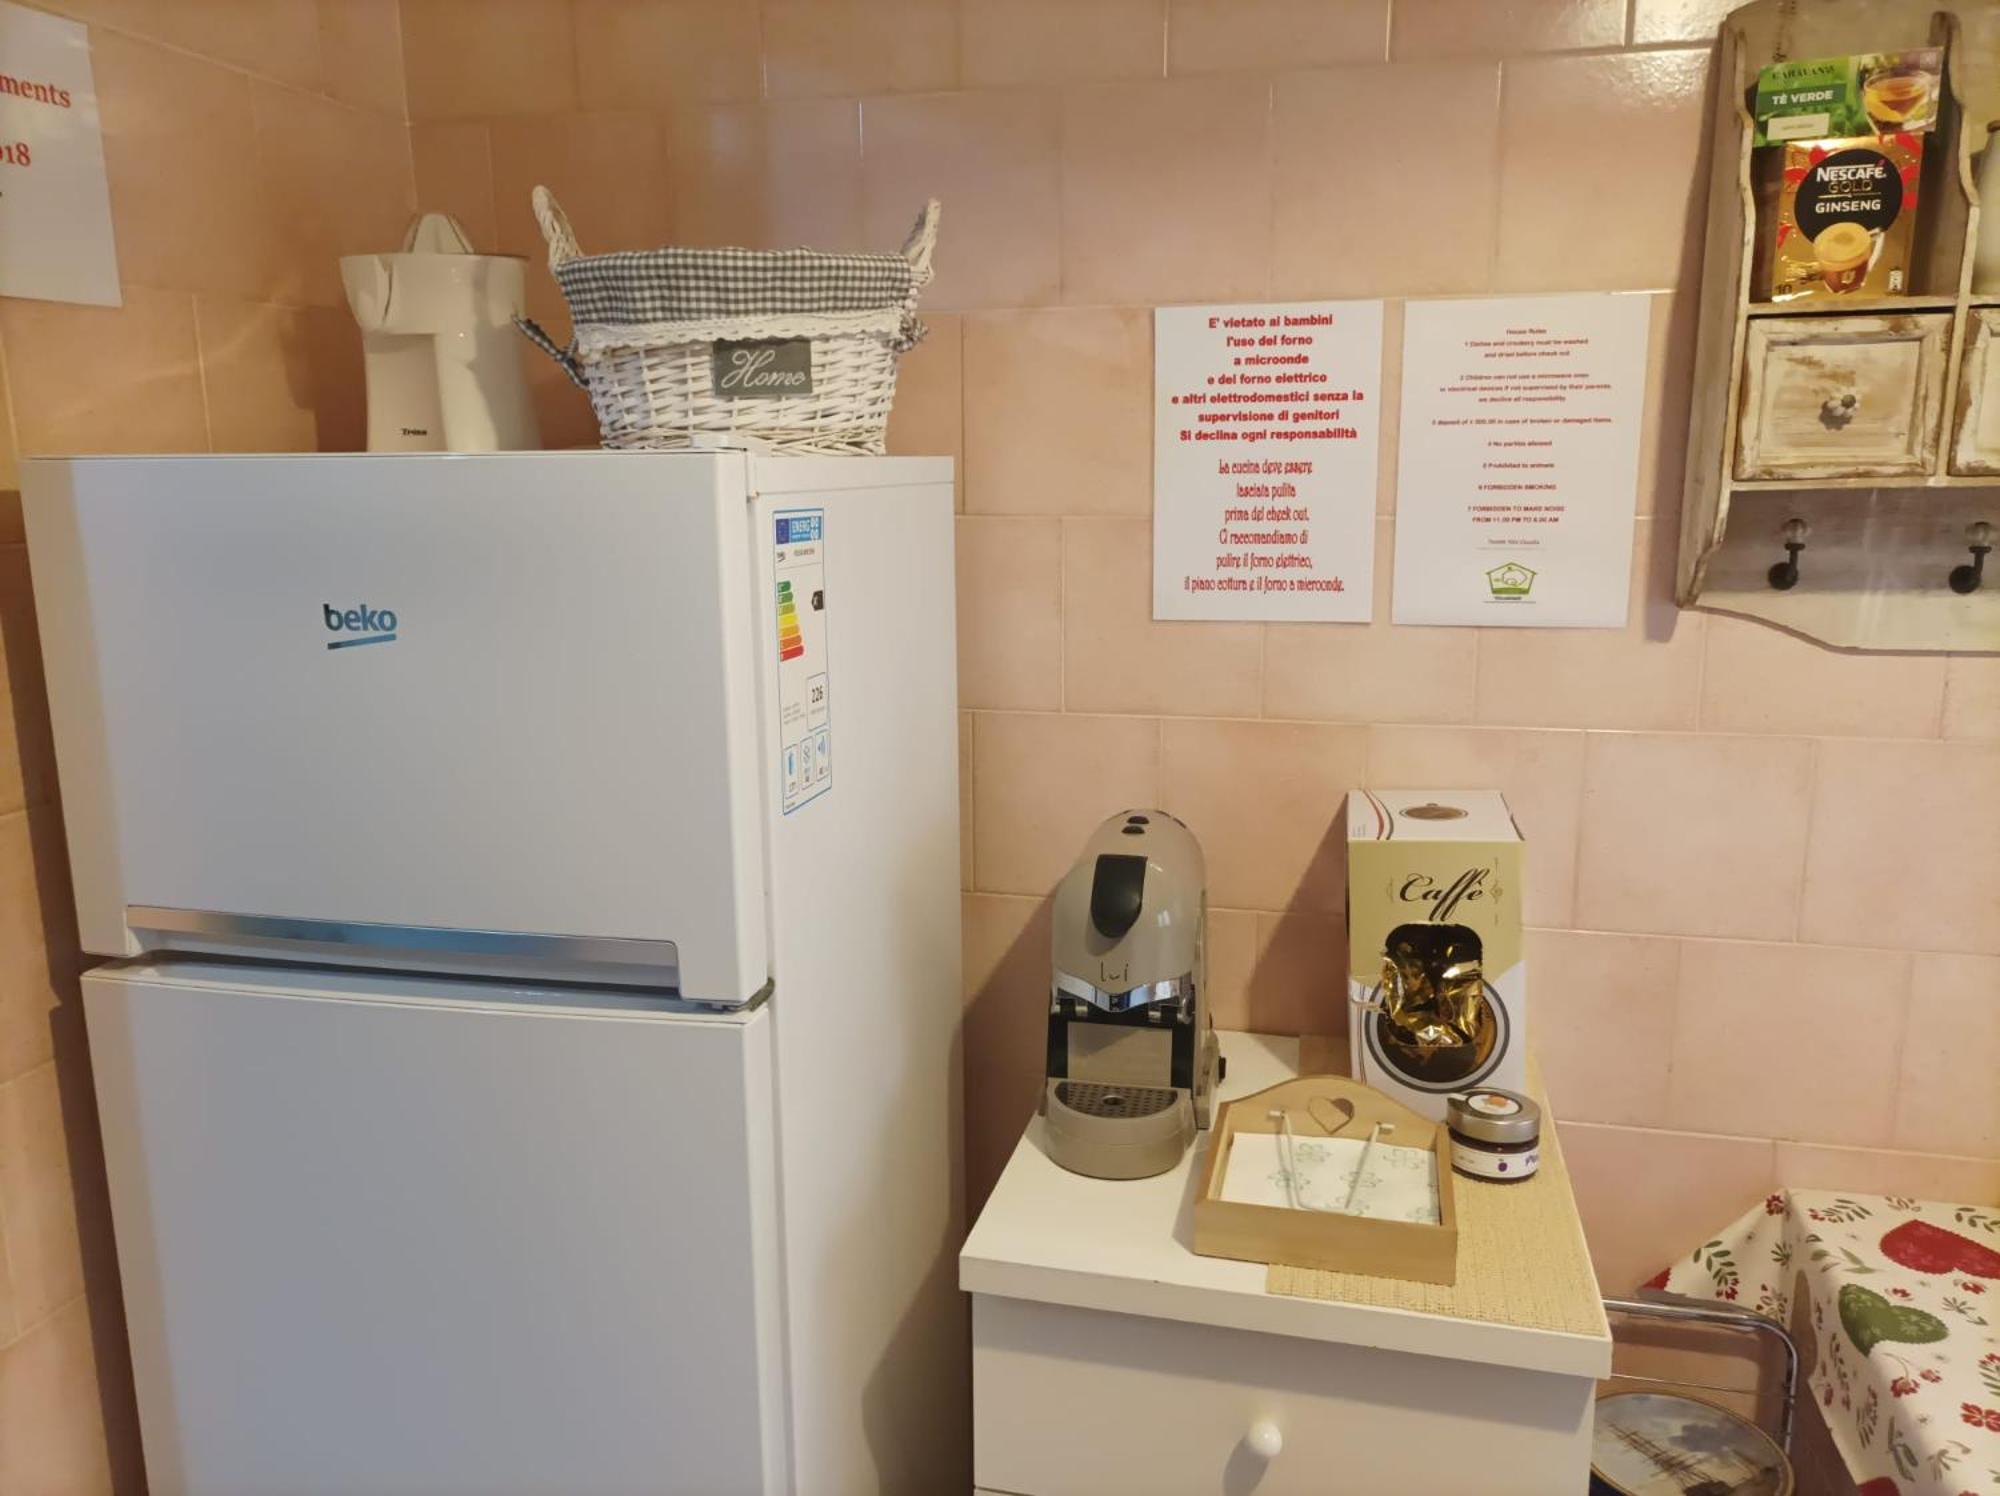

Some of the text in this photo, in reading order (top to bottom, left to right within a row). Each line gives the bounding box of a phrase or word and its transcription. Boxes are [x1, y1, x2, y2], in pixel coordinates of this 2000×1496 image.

[1791, 90, 1834, 103] VERDE
[0, 141, 31, 167] 18
[1828, 180, 1873, 194] GOLD
[1815, 200, 1881, 214] GINSENG
[1224, 318, 1265, 328] vietato
[1270, 316, 1280, 327] ai
[1284, 314, 1333, 326] bambini
[1227, 335, 1313, 347] l'uso del forno
[1234, 354, 1309, 366] a microonde
[721, 349, 806, 389] Home
[1207, 373, 1328, 385] e del forno elettrico
[1172, 390, 1363, 404] e altri elettrodomestici senza la
[1198, 409, 1339, 424] supervisione di genitori
[1180, 428, 1357, 442] Si declina ogni responsabilità
[1219, 459, 1312, 474] La cucina deve essere
[1237, 483, 1296, 501] lasciata pulita
[1225, 507, 1249, 523] prima
[1251, 506, 1264, 522] del
[1266, 506, 1291, 522] check
[1219, 528, 1308, 545] Ci raccomandiamo di
[1216, 553, 1241, 570] pulire
[1243, 552, 1248, 567] il
[1250, 552, 1273, 570] forno
[1185, 576, 1190, 591] il
[1192, 576, 1215, 593] piano
[1217, 576, 1247, 591] cottura
[1249, 579, 1254, 591] e
[1257, 576, 1262, 591] il
[1264, 576, 1287, 594] forno
[1289, 581, 1295, 591] a
[323, 603, 398, 632] beko
